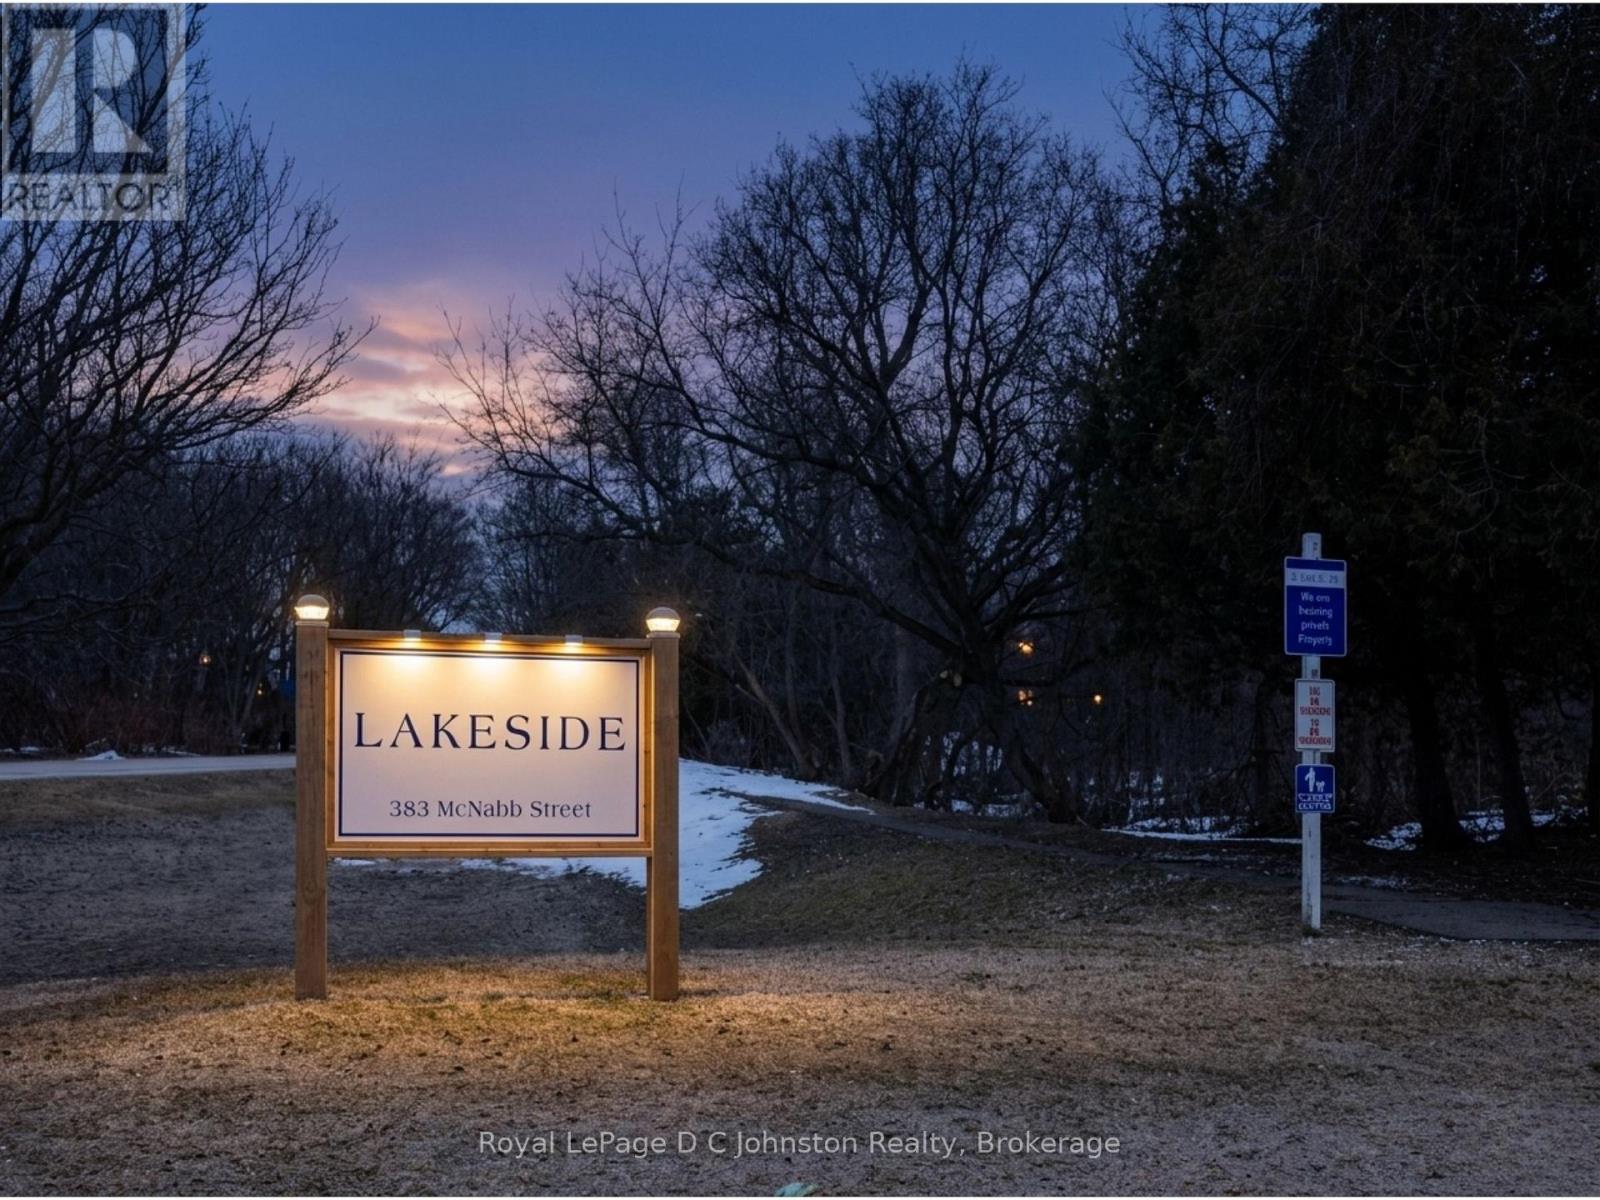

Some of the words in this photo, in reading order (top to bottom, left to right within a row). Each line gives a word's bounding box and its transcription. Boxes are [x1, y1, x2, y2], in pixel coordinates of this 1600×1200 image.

[354, 712, 626, 751] LAKESIDE
[389, 800, 429, 818] 383
[437, 800, 522, 818] McNabb
[530, 801, 592, 818] Street
